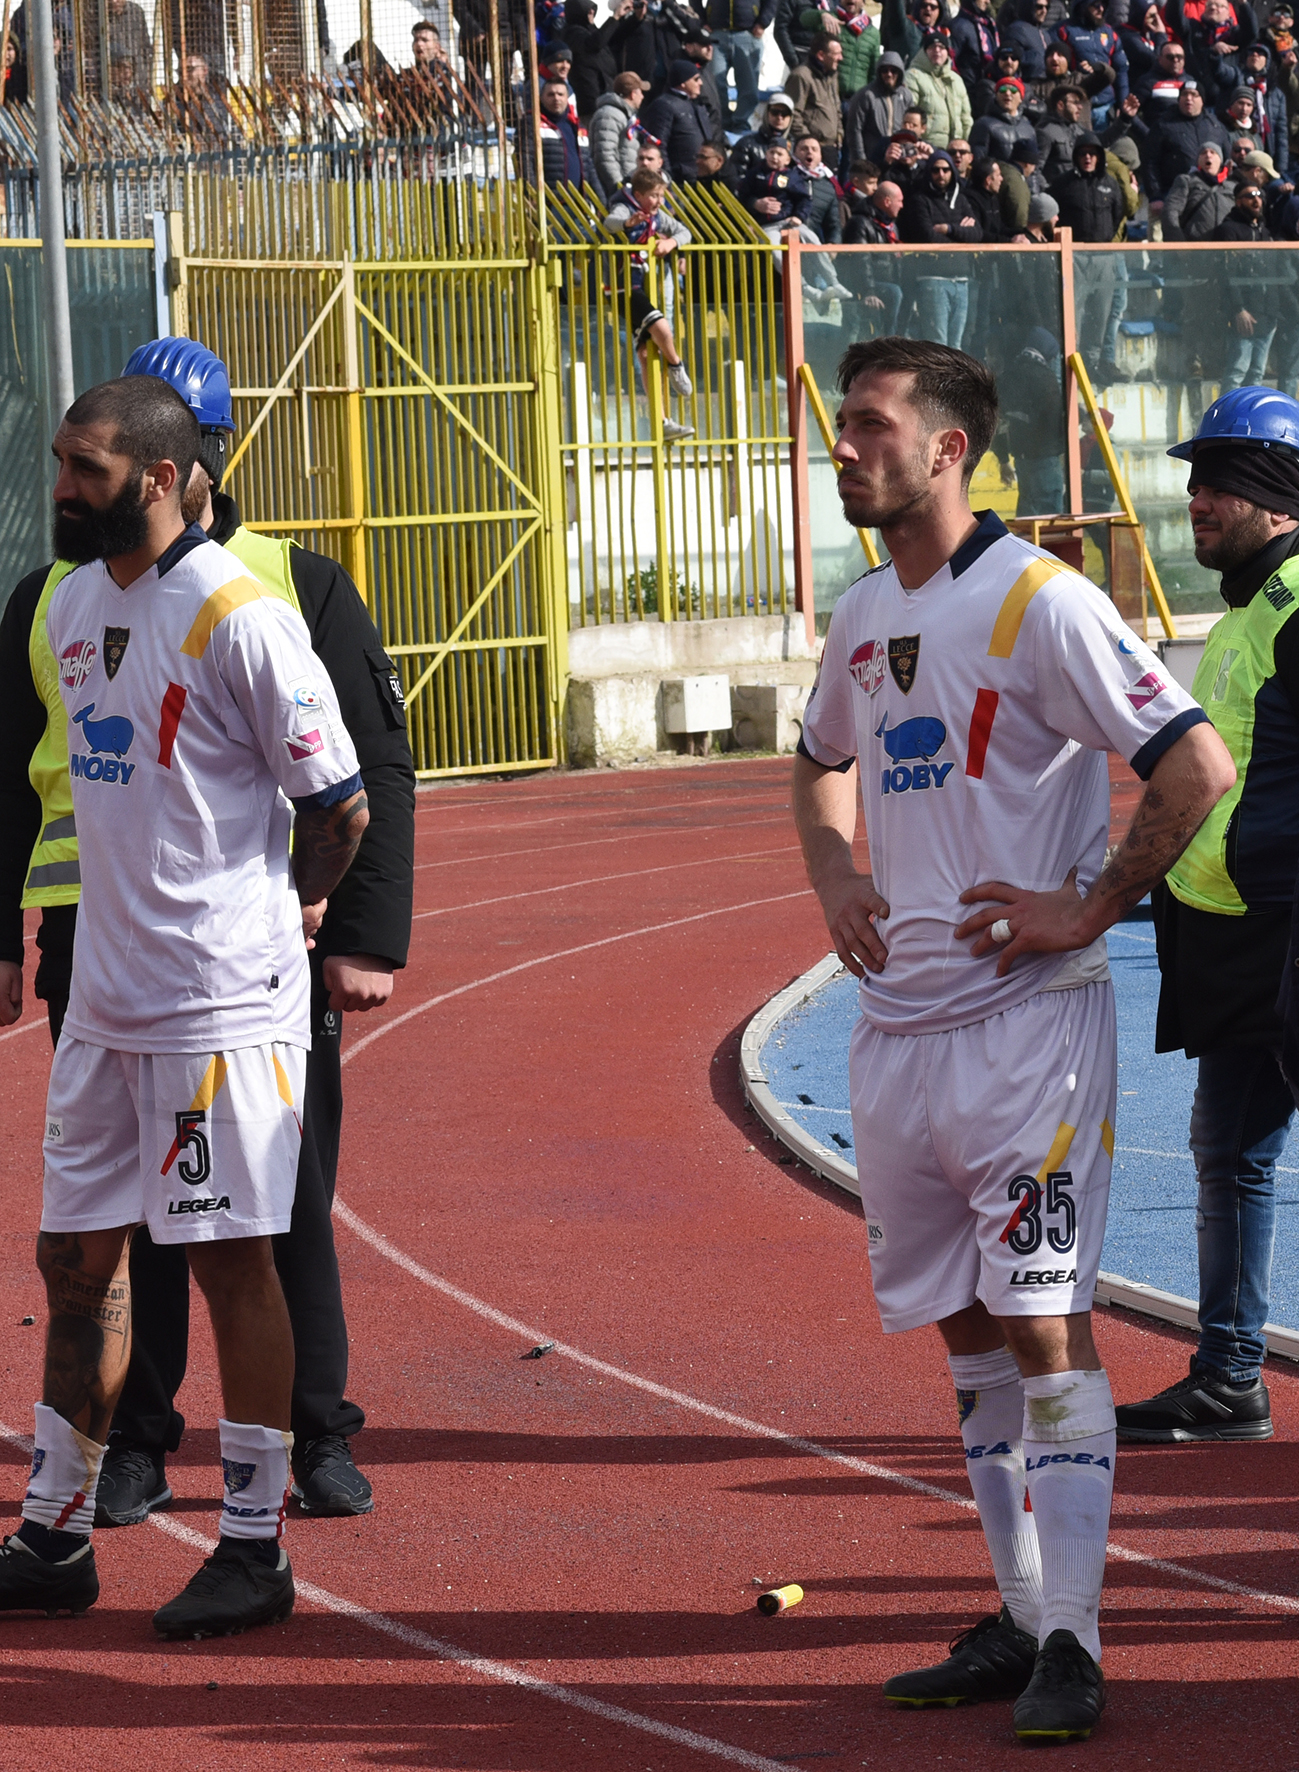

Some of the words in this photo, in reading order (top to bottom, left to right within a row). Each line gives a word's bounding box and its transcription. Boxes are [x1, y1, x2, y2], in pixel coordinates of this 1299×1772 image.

[892, 643, 915, 653] LECCE
[70, 752, 136, 786] MOBY
[175, 1109, 211, 1186] 5
[167, 1196, 231, 1215] LEGEA
[1007, 1171, 1077, 1256] 35
[1009, 1268, 1078, 1286] LEGEA
